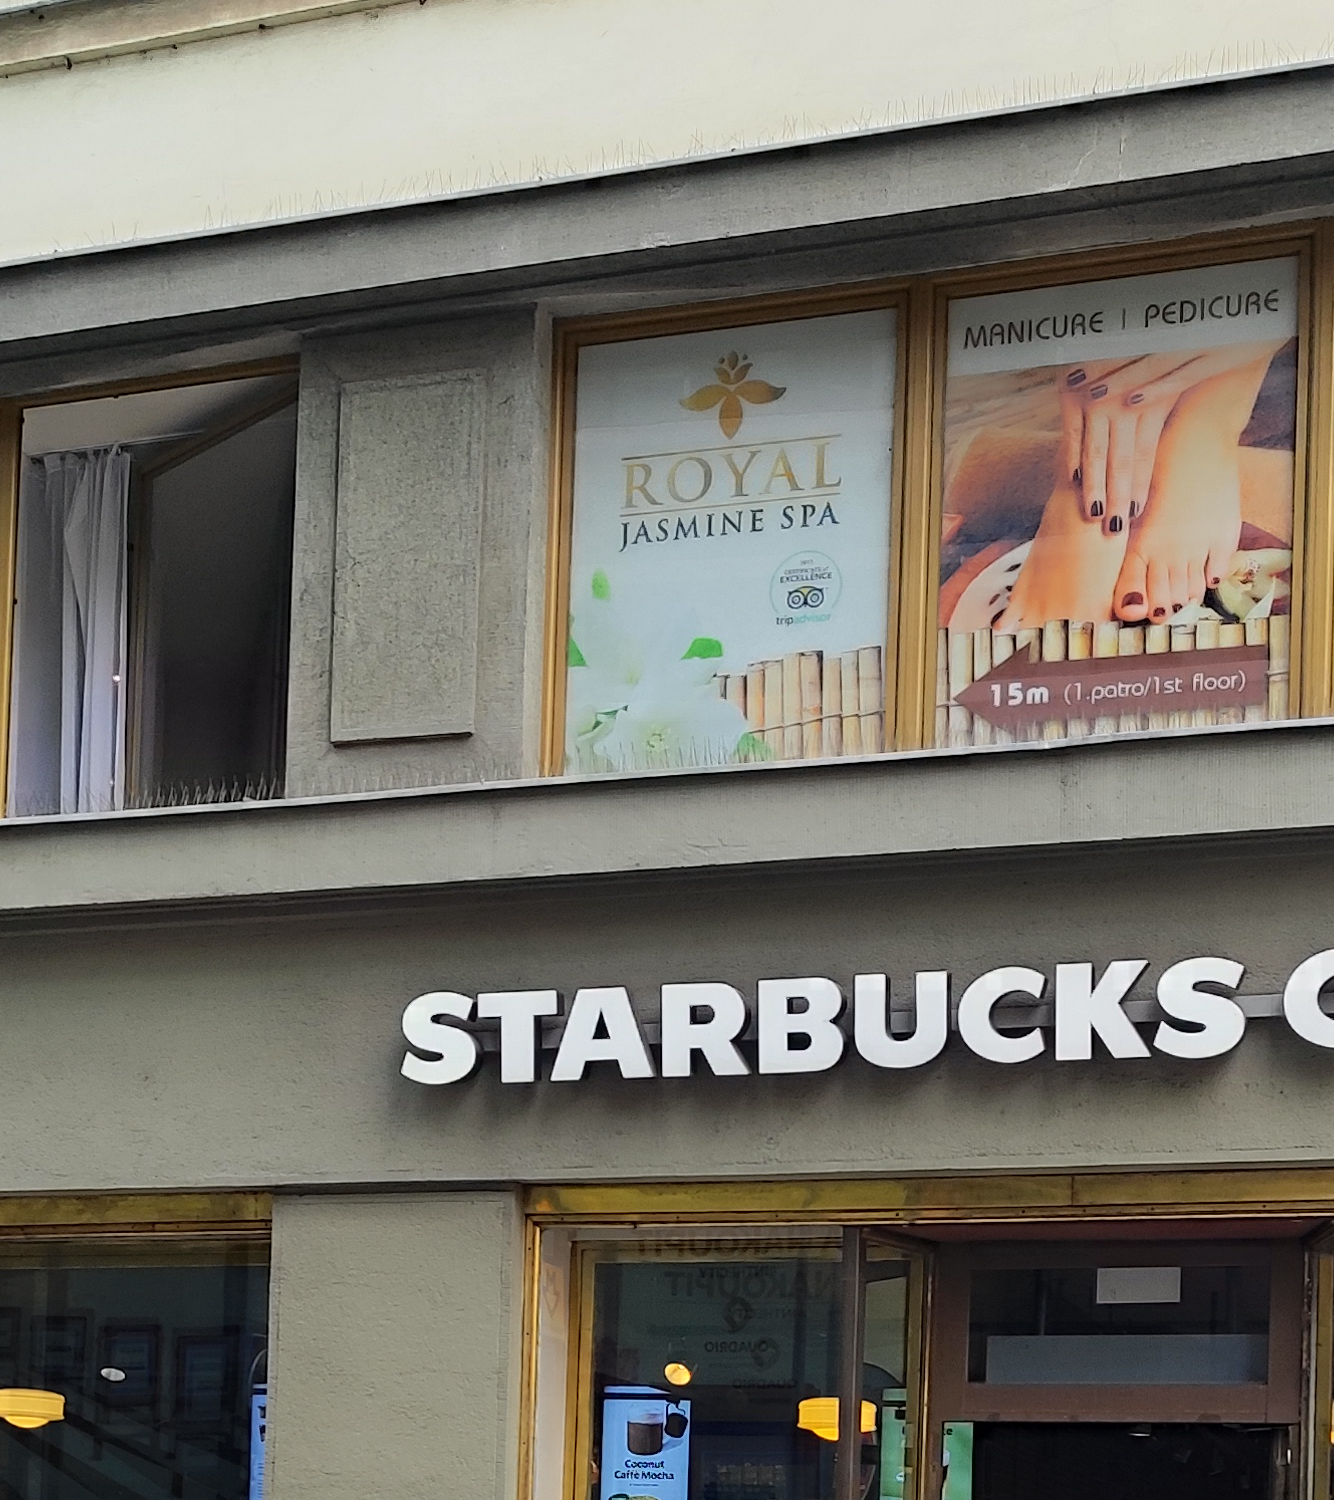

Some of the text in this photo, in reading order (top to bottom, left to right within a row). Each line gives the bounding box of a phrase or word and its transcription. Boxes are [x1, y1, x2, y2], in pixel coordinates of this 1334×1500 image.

[964, 311, 1104, 350] MANICURE
[1144, 288, 1280, 329] PEDICURE
[620, 441, 842, 510] ROYAL
[619, 501, 840, 552] JASMINE SPA
[990, 682, 1050, 708] 15m
[1191, 669, 1247, 694] floor)
[400, 955, 1250, 1085] STARBUCKS
[624, 1459, 665, 1469] Coconut
[641, 1470, 675, 1480] Mocha
